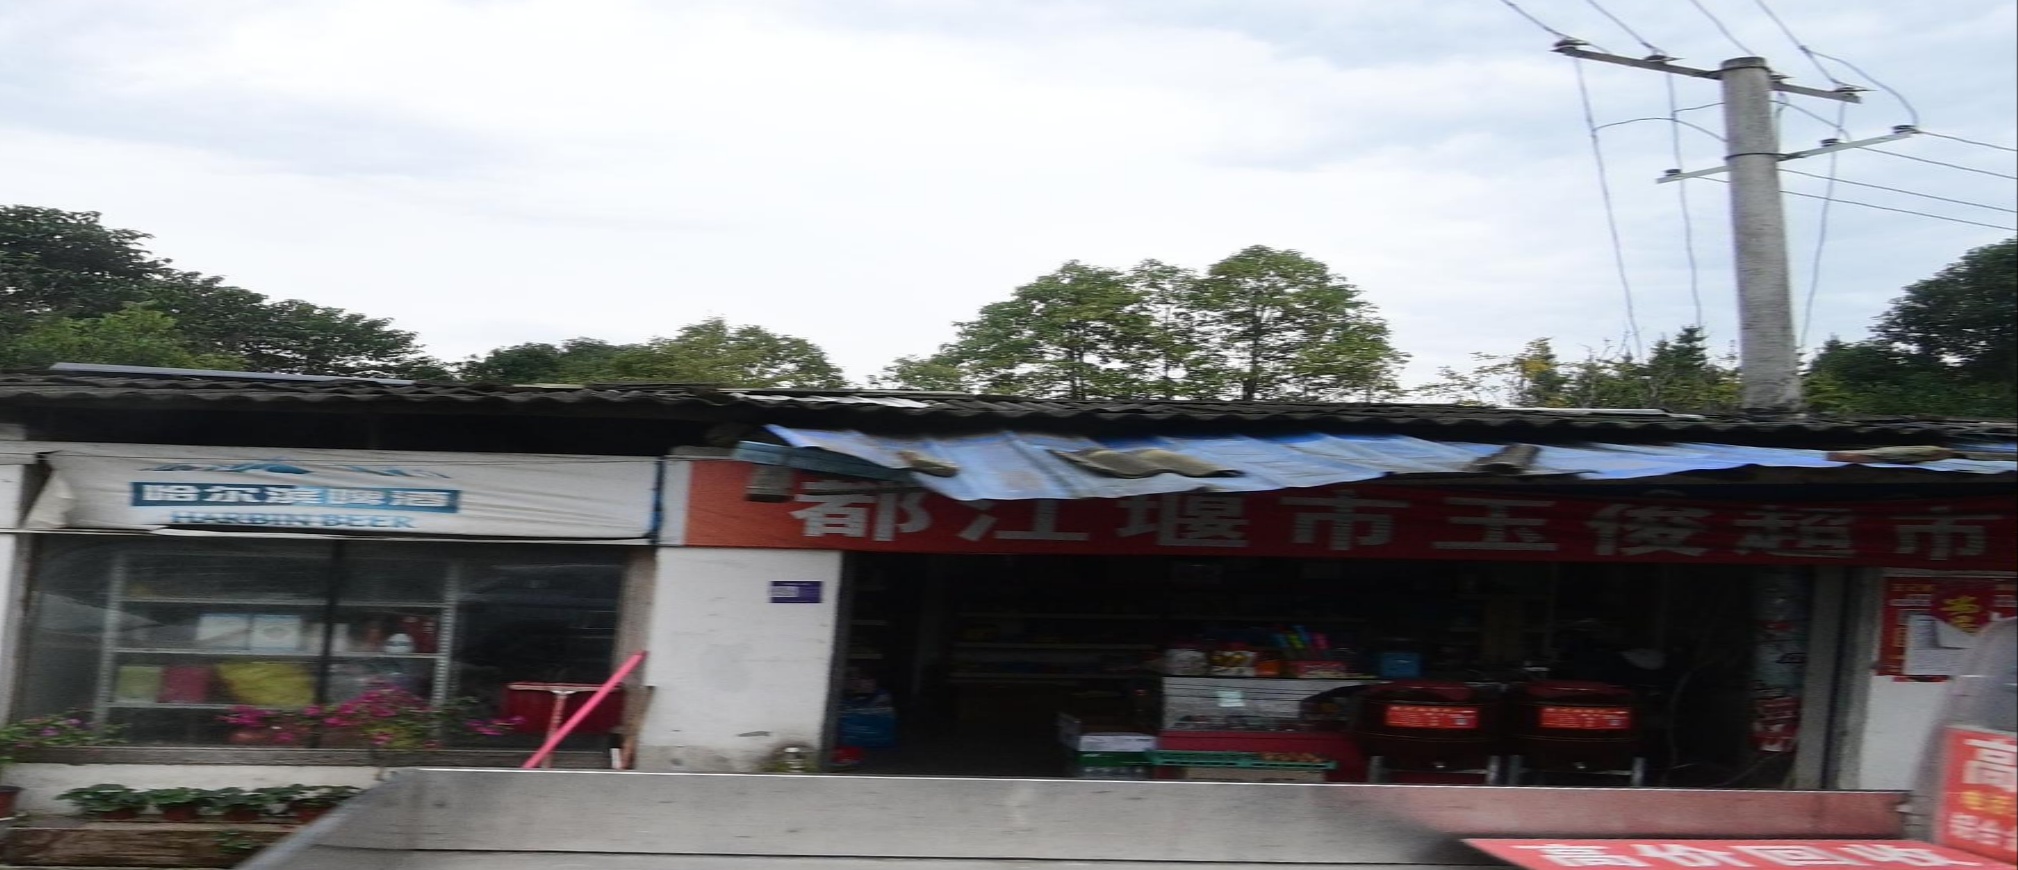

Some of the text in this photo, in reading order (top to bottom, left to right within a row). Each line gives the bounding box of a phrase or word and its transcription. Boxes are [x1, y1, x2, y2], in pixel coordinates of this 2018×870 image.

[142, 483, 451, 507] 哈尔滨啤酒
[171, 511, 416, 529] HARBIN BEER
[790, 479, 2004, 562] 都江堰市玉俊超市
[1513, 844, 1982, 867] 高价回收
